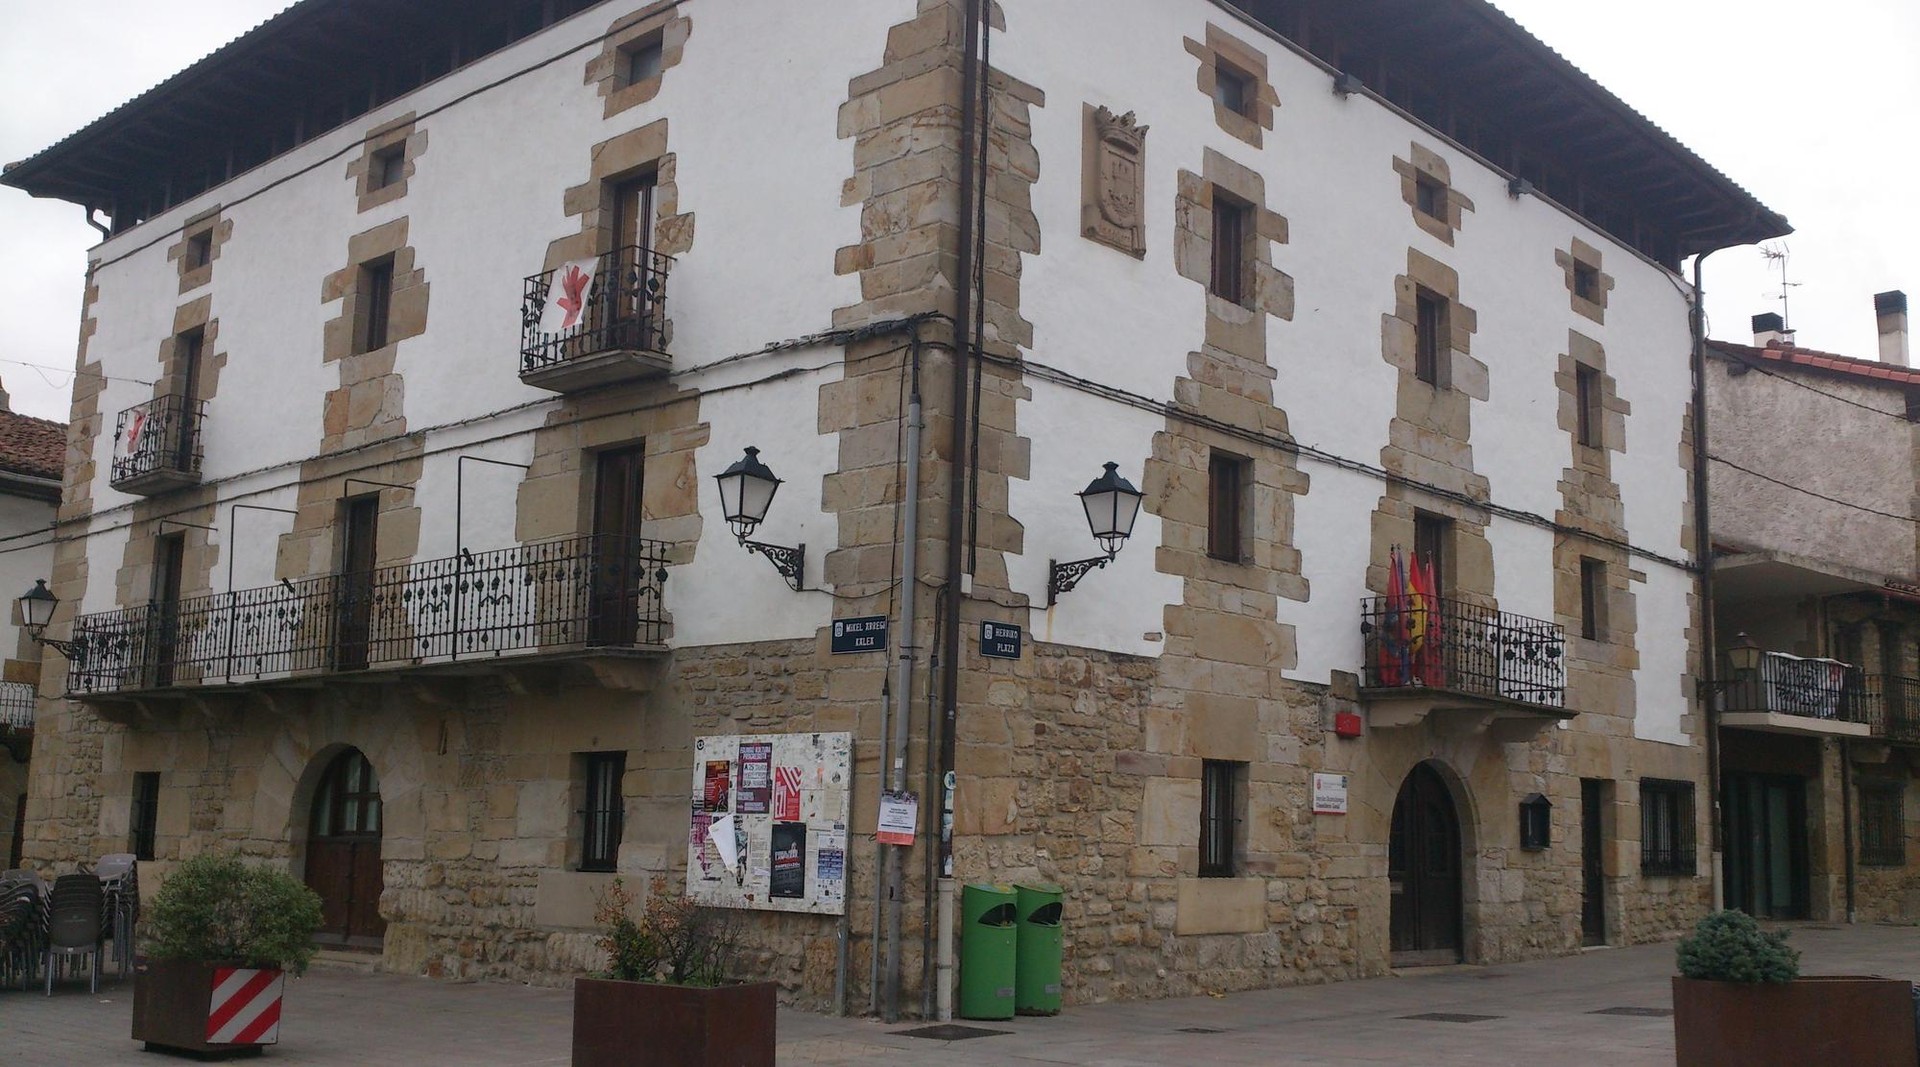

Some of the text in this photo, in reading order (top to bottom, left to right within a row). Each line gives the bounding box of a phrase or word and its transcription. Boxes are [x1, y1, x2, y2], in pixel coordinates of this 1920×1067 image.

[846, 623, 863, 632] MIKEL
[995, 628, 1018, 638] HERRIKO
[856, 637, 874, 646] KALEA
[997, 643, 1015, 653] PLAZA
